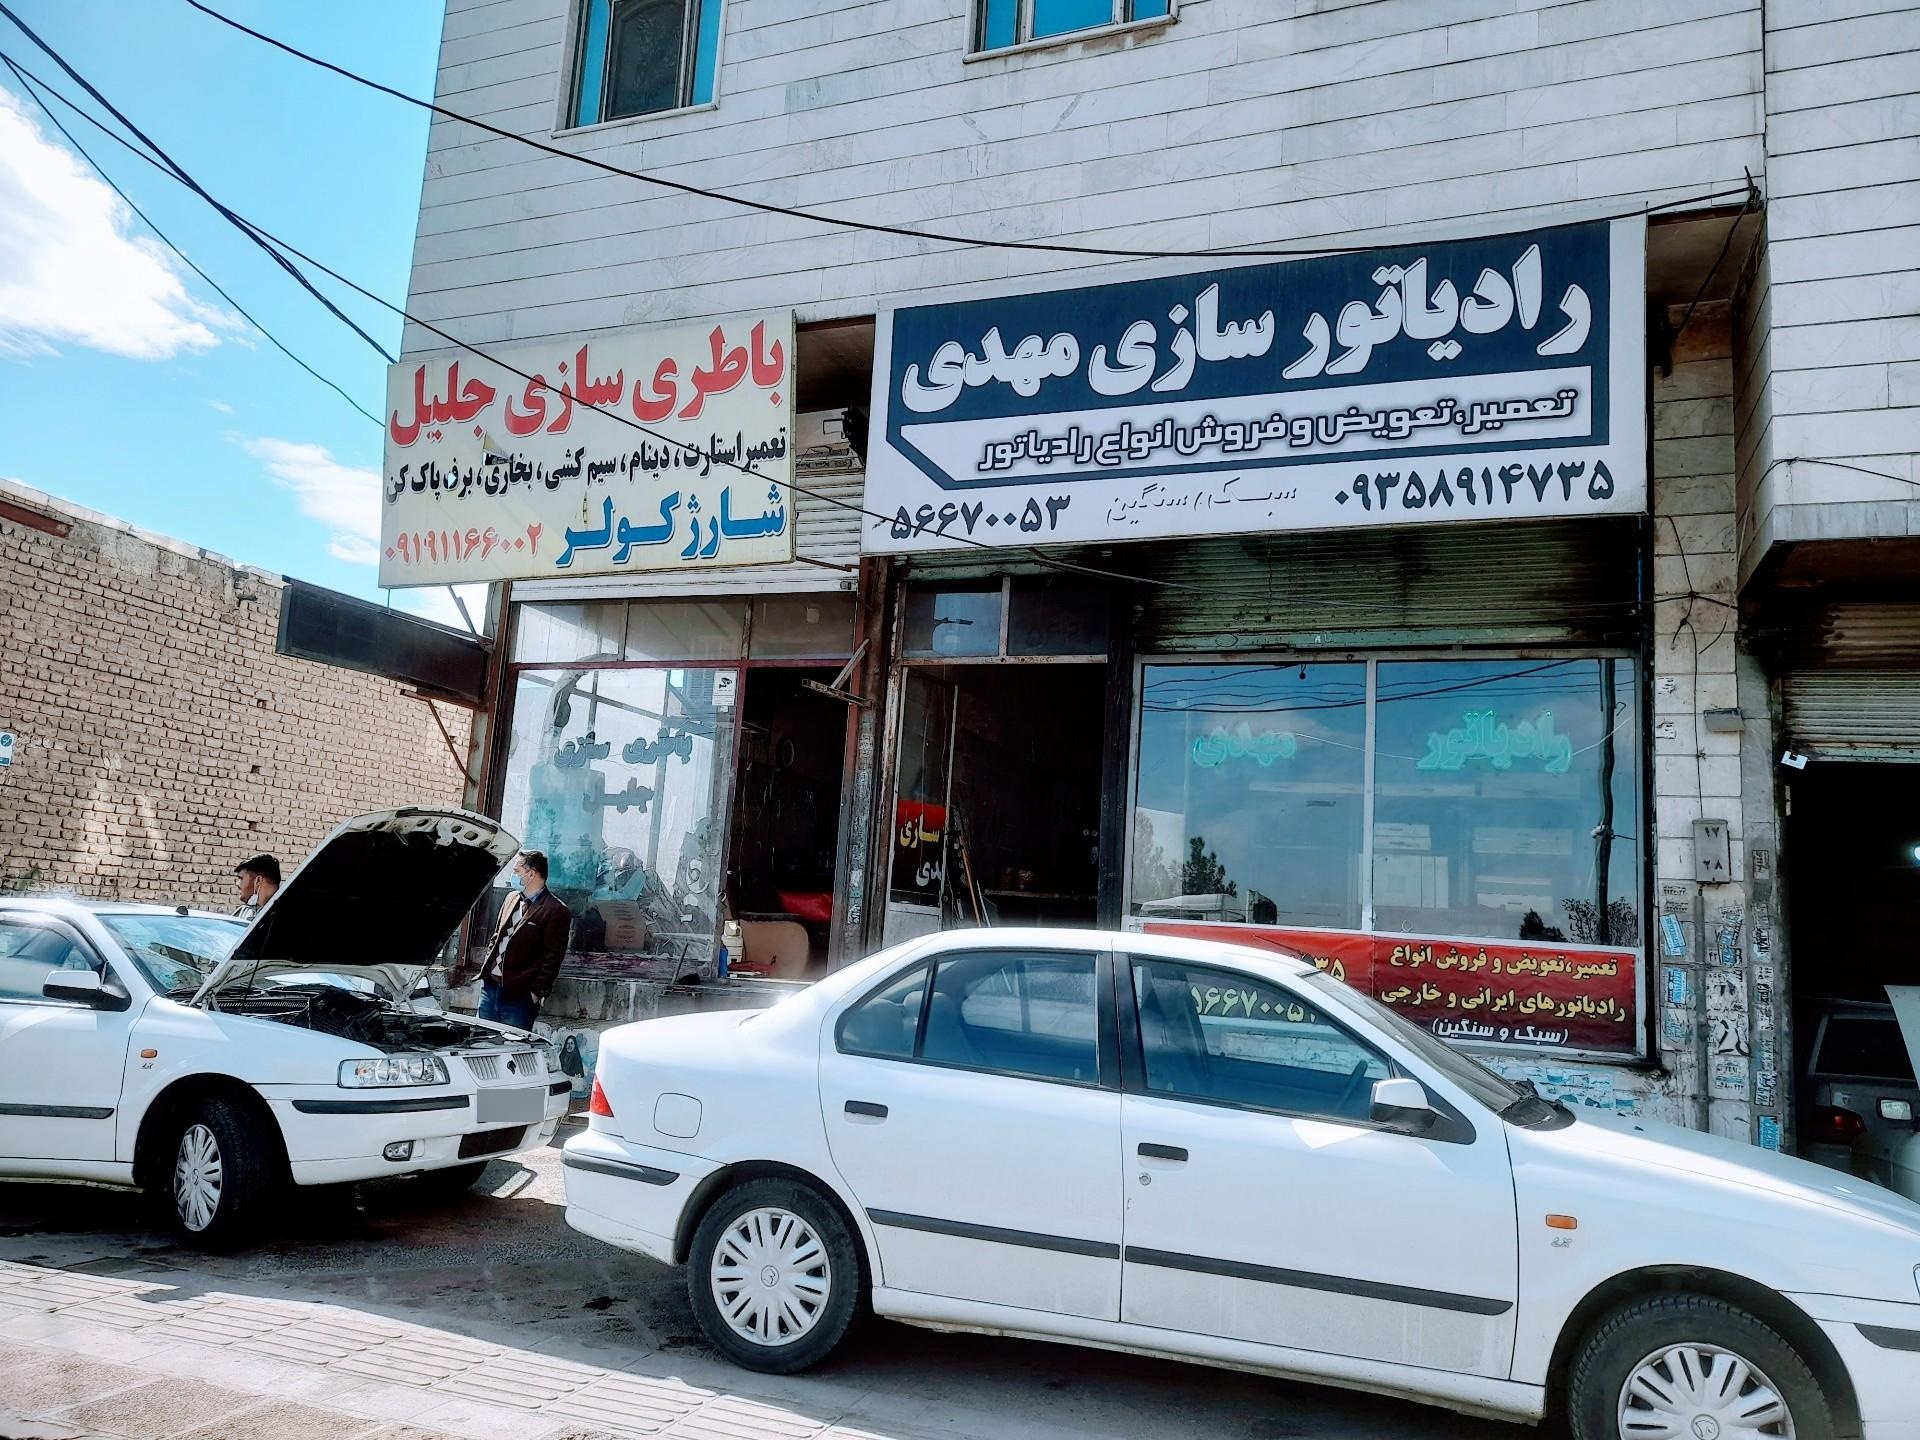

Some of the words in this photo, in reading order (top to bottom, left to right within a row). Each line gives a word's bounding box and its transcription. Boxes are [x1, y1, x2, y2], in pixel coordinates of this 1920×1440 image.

[1282, 243, 1592, 380] رادیاتور
[1088, 282, 1275, 395] سازی
[504, 344, 623, 436] سازی
[632, 319, 785, 422] باطری
[901, 326, 1080, 413] مهدی
[390, 360, 497, 446] جلیل
[741, 428, 786, 471] تعمیر
[977, 427, 1093, 471] رادیاتور
[1094, 418, 1174, 466] انواع
[1175, 413, 1288, 455] فروش
[1290, 416, 1314, 447] و
[386, 466, 408, 503] کن
[411, 461, 441, 500] پاک
[587, 456, 616, 485] سیم
[1335, 459, 1614, 511] ۰۹۳۵۸۹۱۴۷۳۵
[556, 491, 680, 568] کولر
[681, 483, 787, 559] شارژ
[891, 494, 1071, 539] ۵۶۶۷۰۰۵۳
[384, 522, 543, 565] ۰۹۱۹۱۱۶۶۰۰۲
[622, 727, 693, 765] باطری
[1416, 709, 1572, 772] رادیاتور
[1390, 944, 1432, 968] انواع
[1436, 948, 1487, 971] فروش
[1491, 959, 1502, 973] و
[1191, 986, 1316, 1023] ۶۶۷۰۰۵
[1381, 982, 1441, 1004] خارجی
[1446, 991, 1456, 1008] و
[1461, 987, 1514, 1011] ایرانی
[1499, 1028, 1509, 1041] و
